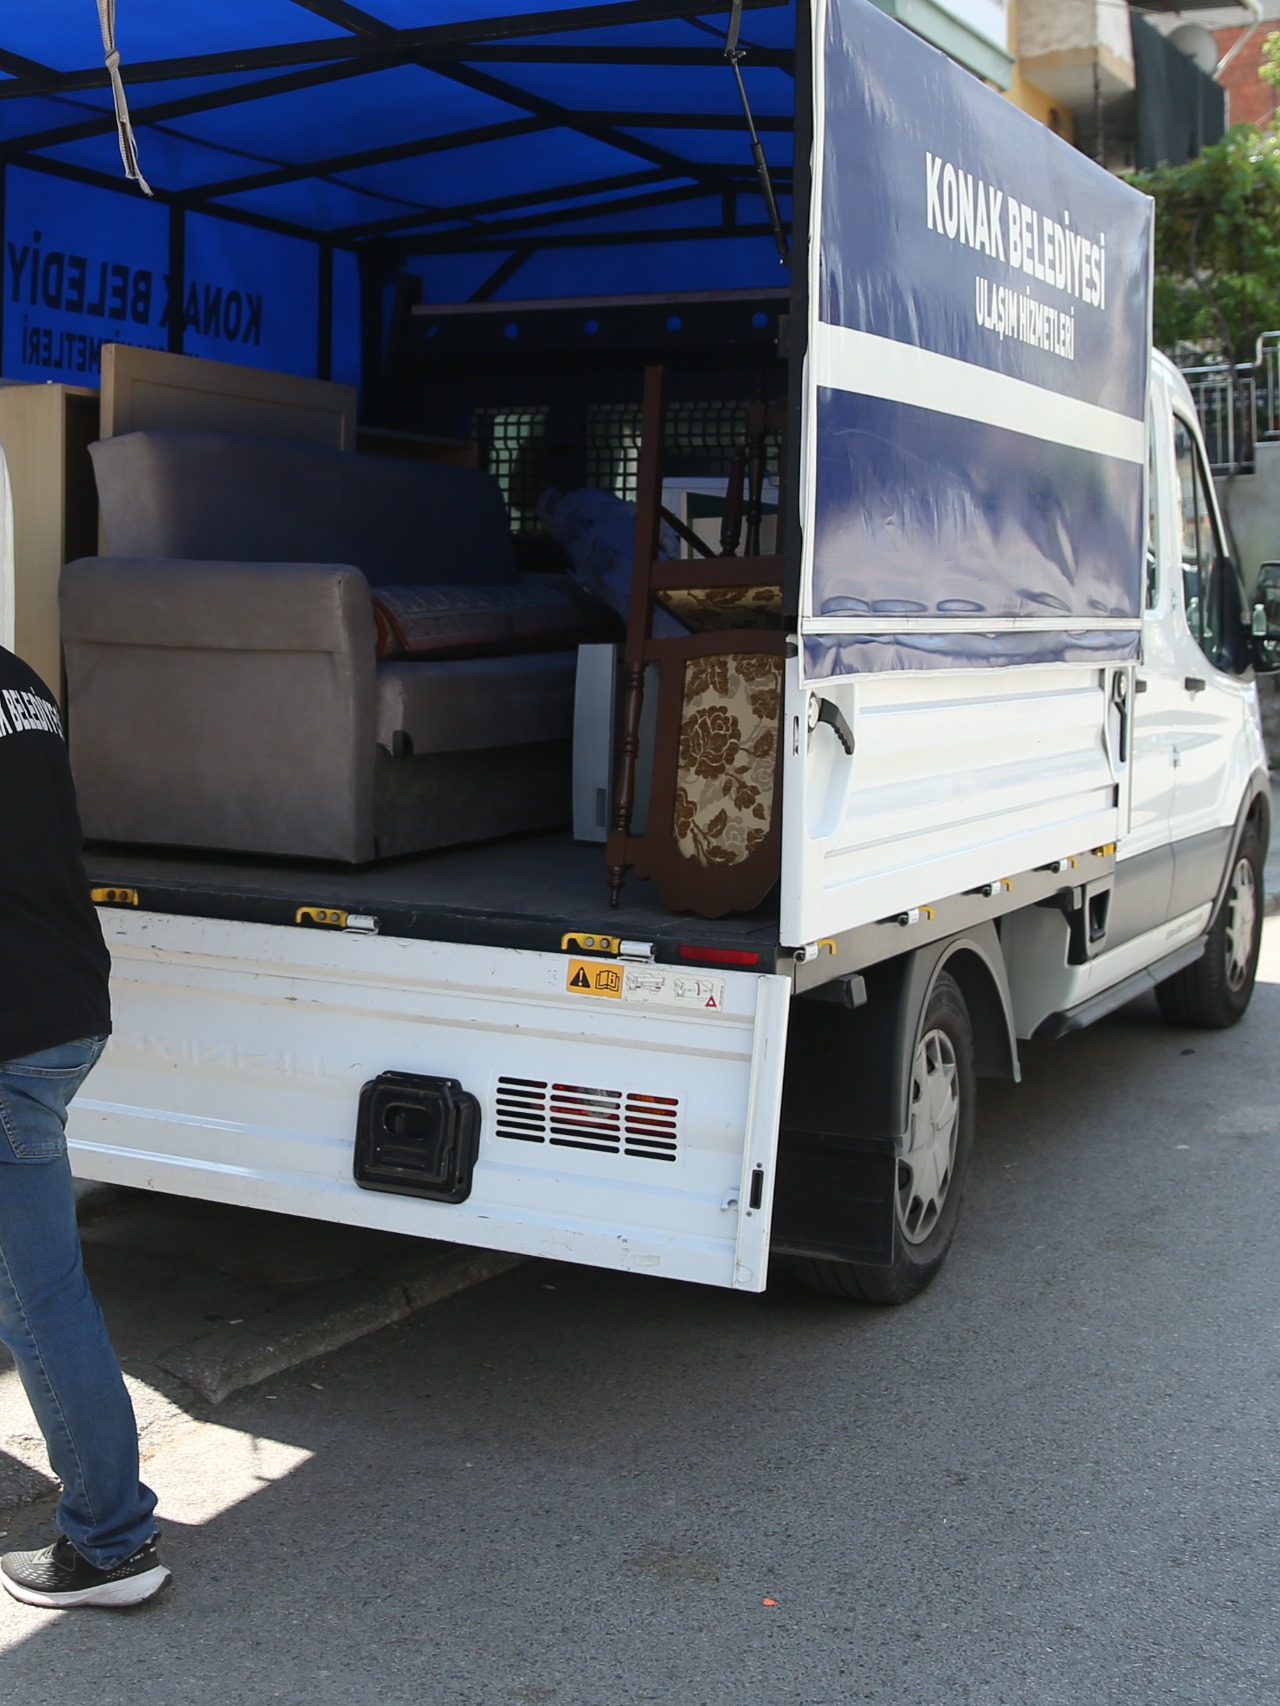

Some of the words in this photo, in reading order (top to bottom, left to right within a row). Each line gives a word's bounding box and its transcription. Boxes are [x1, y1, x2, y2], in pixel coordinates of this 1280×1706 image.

[926, 151, 1005, 262] KONAK
[1008, 196, 1105, 310] BELEDİYESİ
[976, 276, 1018, 340] ULAŞIM
[1019, 285, 1074, 360] HİZMETLERİ
